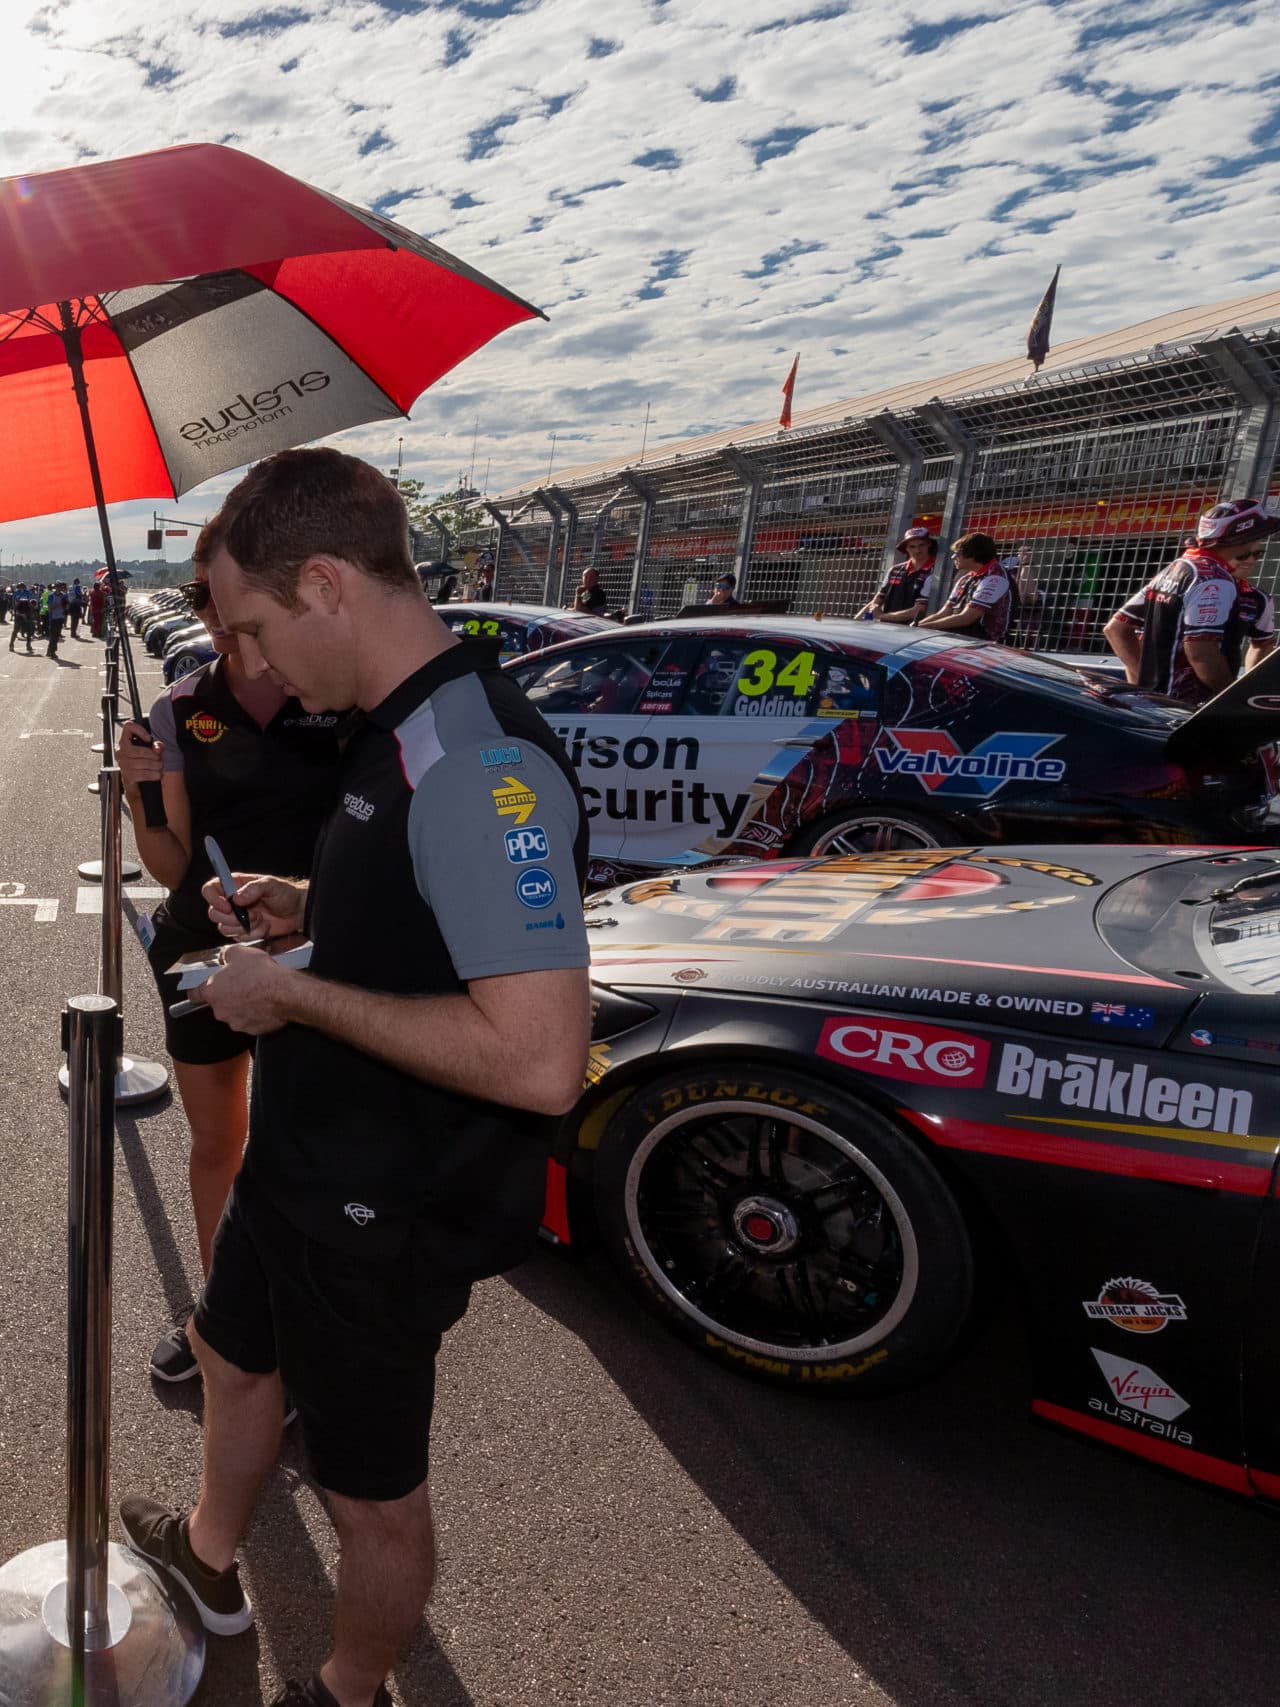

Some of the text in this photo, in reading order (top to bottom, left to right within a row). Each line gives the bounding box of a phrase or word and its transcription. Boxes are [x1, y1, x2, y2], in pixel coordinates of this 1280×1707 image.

[737, 650, 816, 695] 34
[556, 728, 699, 771] ilson
[874, 748, 1065, 781] Valvoline
[582, 780, 752, 839] curity
[508, 832, 545, 859] PPG
[522, 881, 552, 897] CM
[790, 978, 906, 999] AUSTRALIAN
[908, 987, 970, 1006] MADE
[975, 992, 992, 1007] &
[995, 995, 1084, 1016] OWNED
[829, 1025, 976, 1078] CRC
[995, 1043, 1253, 1135] Brākleen
[1087, 1304, 1182, 1317] OUTBACK JACKS
[1111, 1369, 1176, 1409] Virgin
[1088, 1397, 1193, 1445] australia
